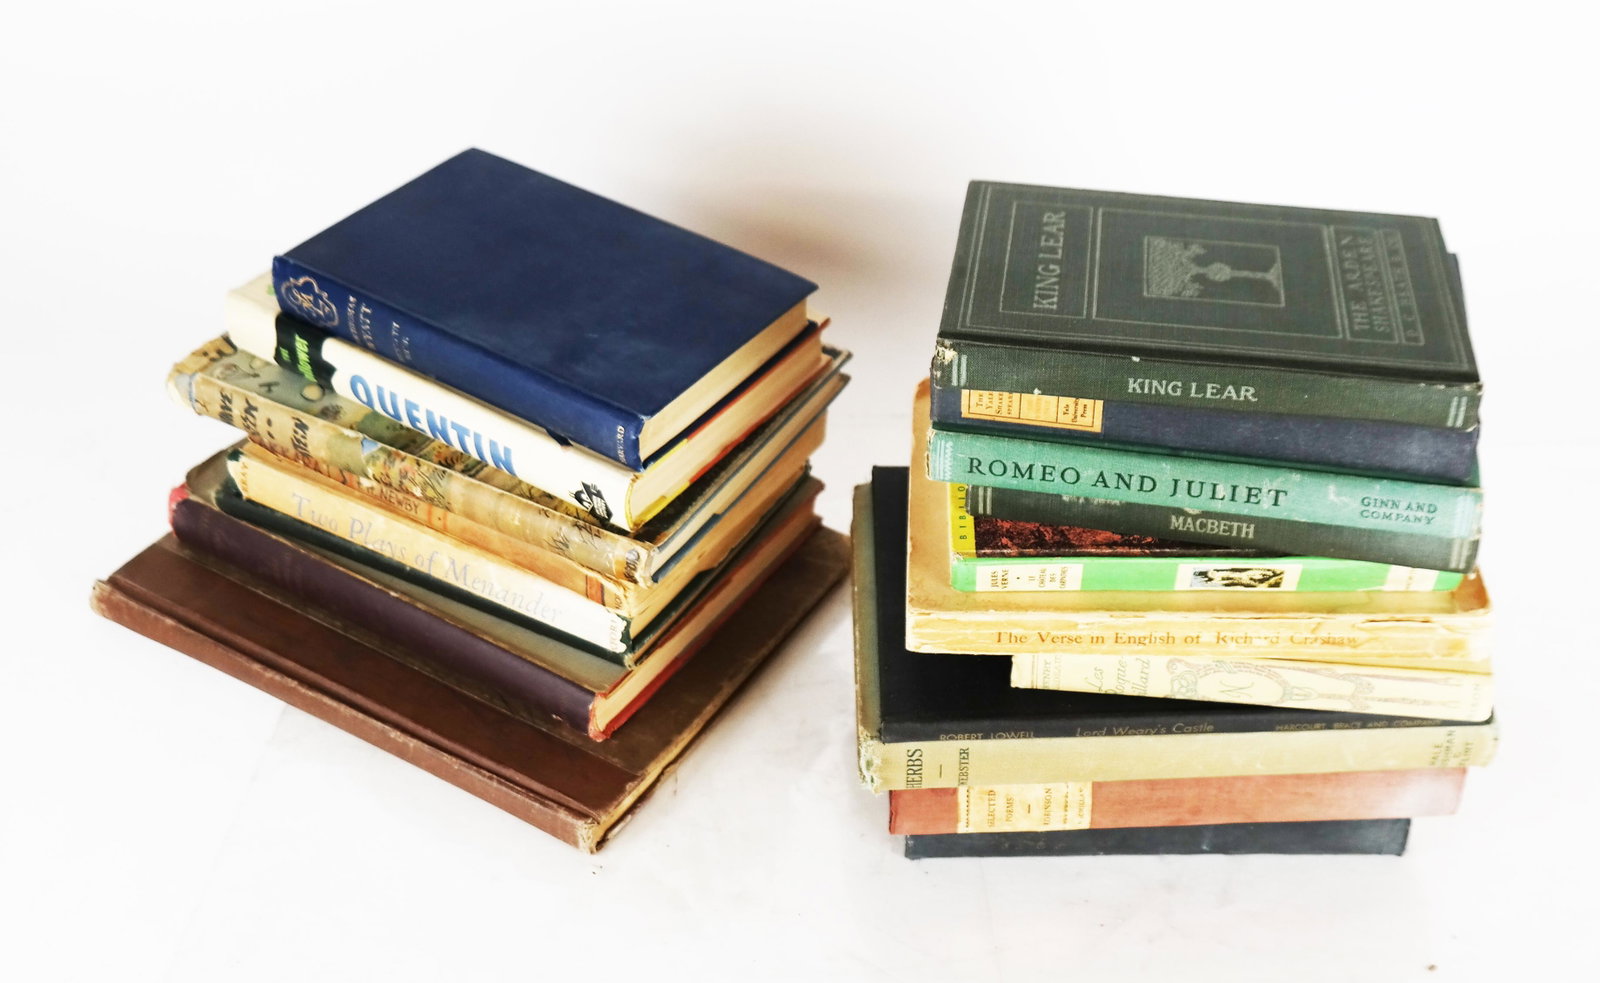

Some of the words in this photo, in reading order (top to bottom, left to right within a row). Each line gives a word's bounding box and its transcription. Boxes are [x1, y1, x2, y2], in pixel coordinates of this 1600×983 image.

[1038, 211, 1066, 260] LEAR
[1033, 264, 1060, 310] KING
[1351, 301, 1371, 331] THE
[1128, 377, 1183, 397] KING
[1190, 382, 1259, 402] LEAR
[349, 374, 518, 477] QUENTIN
[967, 457, 1082, 485] ROMEO
[1091, 470, 1158, 493] AND
[1169, 478, 1288, 507] JULIET
[1360, 509, 1436, 525] COMPANY
[1361, 496, 1400, 510] GINN
[1405, 501, 1438, 514] AND
[1170, 514, 1256, 539] MACBETH
[292, 492, 339, 532] Two
[349, 517, 407, 560] Plays
[414, 550, 439, 575] of
[445, 555, 566, 621] Menander
[991, 569, 999, 588] JULES
[1001, 568, 1009, 590] VERNE
[994, 631, 1028, 644] The
[1037, 631, 1083, 644] Verse
[1090, 632, 1105, 644] in
[1114, 631, 1176, 646] English
[1184, 631, 1201, 644] of
[939, 732, 984, 741] ROBERT
[990, 731, 1035, 740] LOWELL
[1075, 726, 1107, 738] Lord
[1112, 724, 1167, 737] Weary's
[1172, 722, 1215, 734] Castle
[1275, 722, 1327, 732] HARCOURT
[1367, 720, 1389, 729] AND
